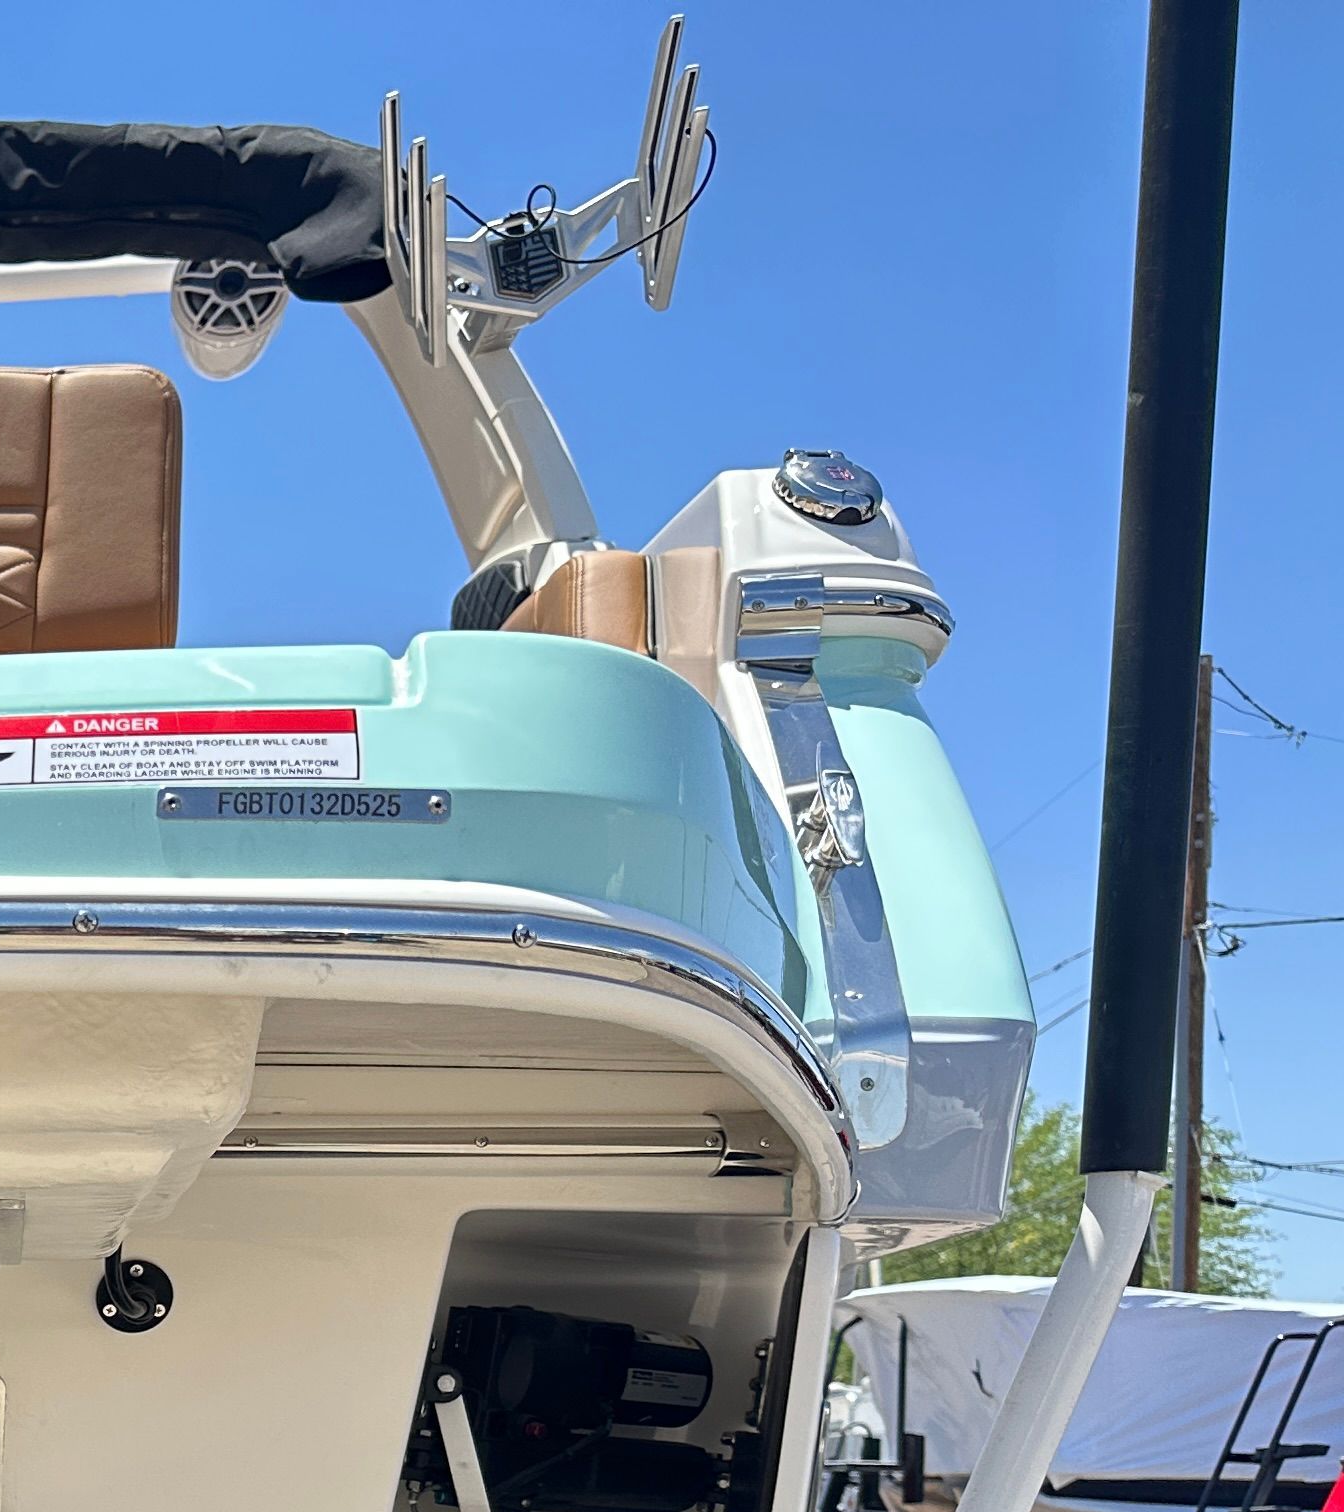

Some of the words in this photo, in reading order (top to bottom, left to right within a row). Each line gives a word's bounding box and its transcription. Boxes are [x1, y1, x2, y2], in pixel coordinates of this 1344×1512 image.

[73, 718, 160, 733] DANGER
[50, 741, 101, 751] CONTACT
[103, 741, 130, 749] WITH
[143, 740, 193, 748] SPINNING
[195, 738, 260, 747] PROPELLER
[291, 738, 328, 746] CAUSE
[50, 750, 97, 758] SERIOUS
[99, 749, 137, 757] INJURY
[49, 763, 77, 772] STAY
[80, 763, 116, 771] CLEAR
[118, 762, 133, 770] OF
[136, 761, 166, 769] BOAT
[168, 761, 191, 769] AND
[194, 760, 222, 768] STAY
[280, 759, 339, 767] PLATFORM
[49, 772, 72, 780] AND
[75, 771, 132, 779] BOARDING
[134, 770, 178, 778] LADDER
[180, 769, 214, 777] WHILE
[217, 768, 258, 776] ENGINE
[217, 791, 402, 818] FGBT0132D525
